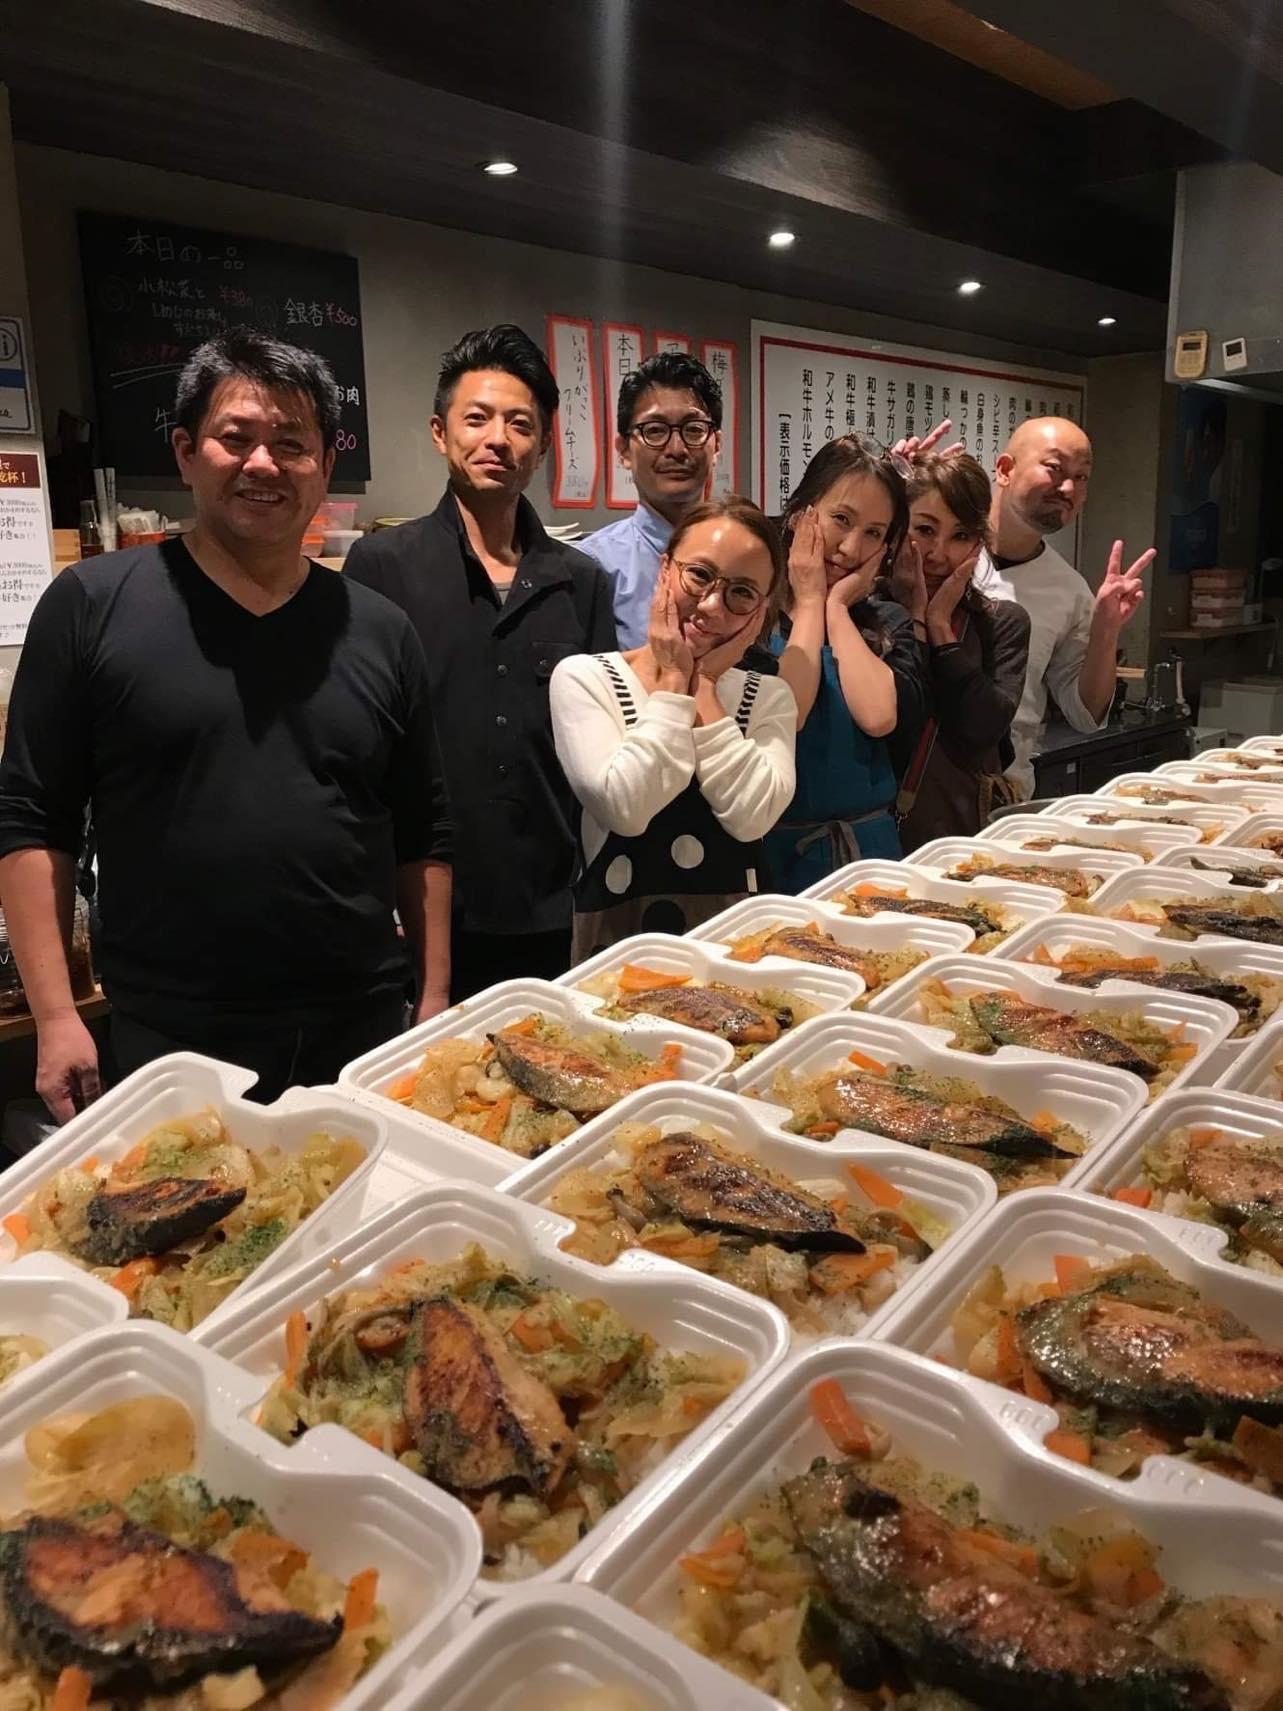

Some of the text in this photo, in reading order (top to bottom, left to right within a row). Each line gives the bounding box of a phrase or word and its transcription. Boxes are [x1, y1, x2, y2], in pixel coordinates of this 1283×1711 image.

[127, 228, 246, 271] 本日の一品
[616, 333, 634, 376] 本日
[801, 369, 814, 467] 和牛ホルモ
[824, 372, 836, 440] アメ牛の
[886, 379, 896, 446] 牛サガリ
